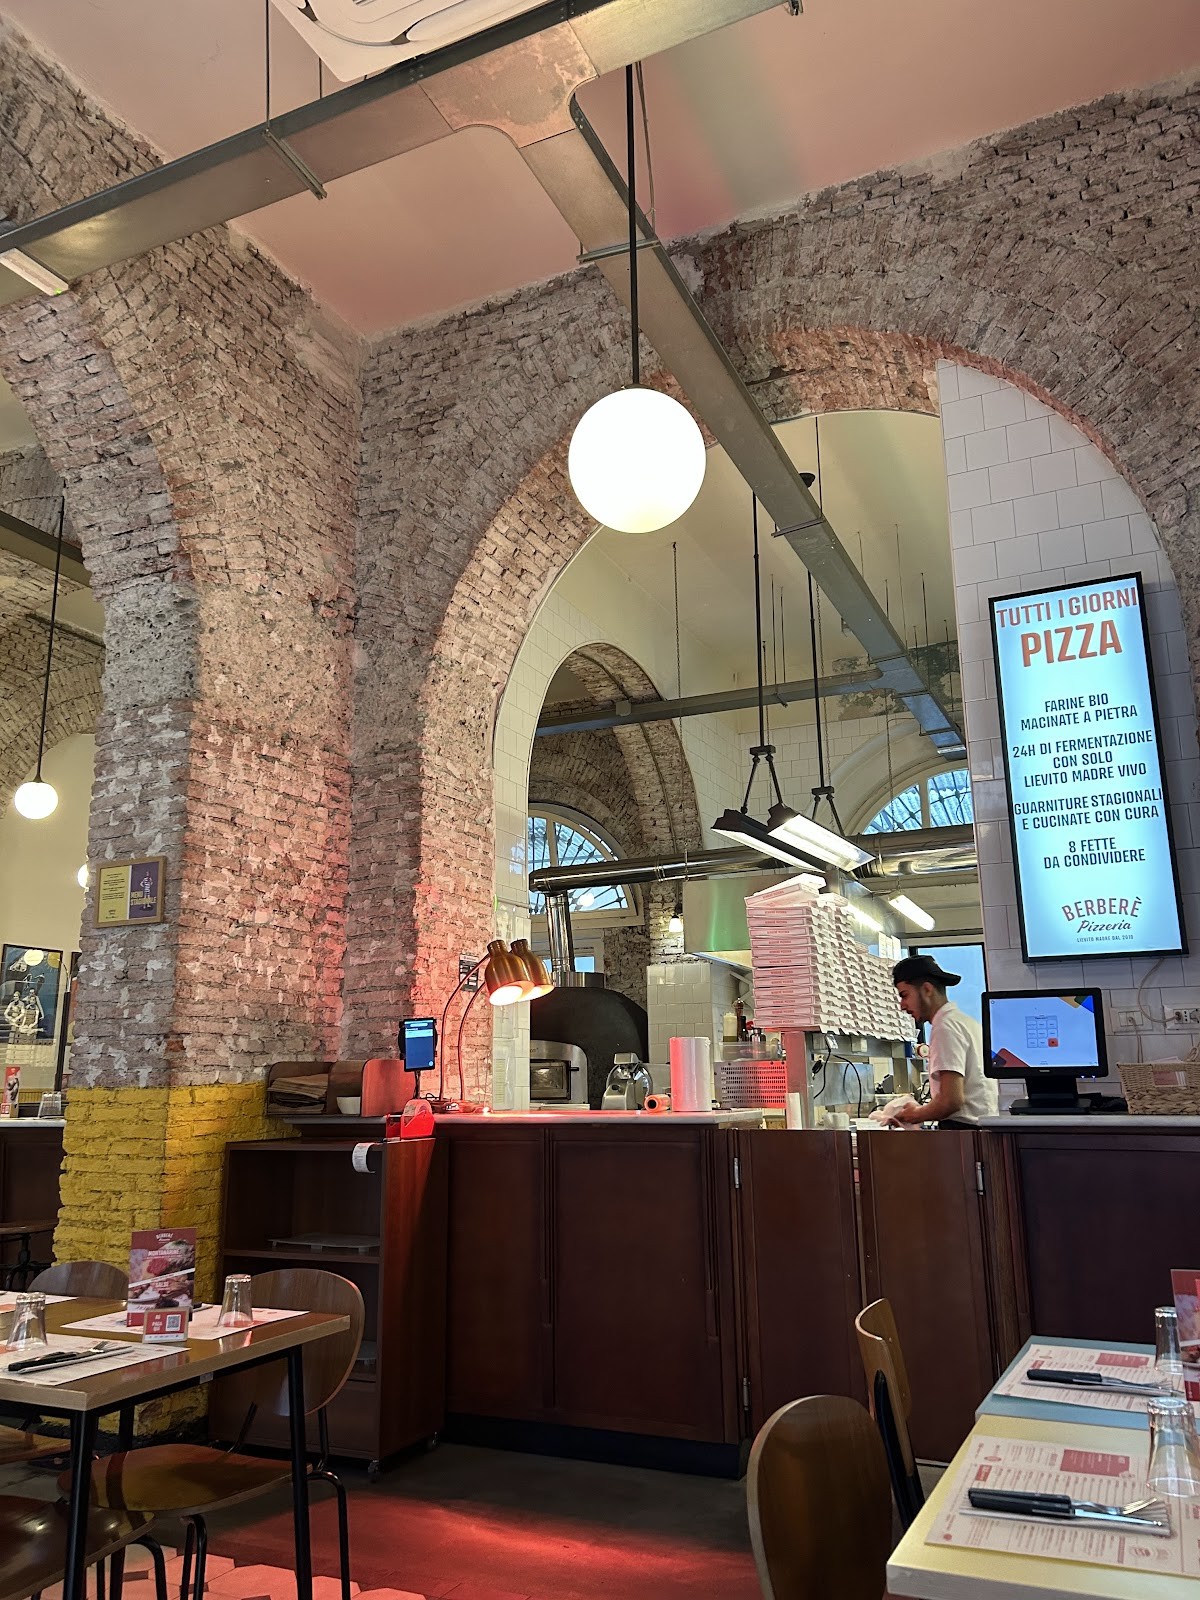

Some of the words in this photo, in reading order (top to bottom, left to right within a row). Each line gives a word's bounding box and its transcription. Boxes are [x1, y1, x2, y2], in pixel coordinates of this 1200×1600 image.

[996, 602, 1052, 627] TUTTI
[1058, 599, 1065, 618] I
[1068, 587, 1138, 617] GIORNI
[1020, 620, 1123, 667] PIZZA
[1044, 696, 1085, 712] FARINE
[1088, 693, 1110, 707] BIO
[1020, 713, 1081, 731] MACINATE
[1083, 711, 1092, 723] A
[1095, 705, 1139, 721] PIETRA
[1012, 745, 1036, 758] 24H
[1039, 742, 1052, 755] DI
[1055, 730, 1154, 753] FERMENTAZIONE
[1052, 755, 1079, 769] CON
[1081, 751, 1113, 765] SOLO
[1023, 771, 1068, 787] LIEVITO
[1072, 766, 1115, 782] MADRE
[1117, 763, 1148, 777] VIVO
[1014, 796, 1090, 815] GUARNITURE
[1090, 788, 1163, 807] STAGIONALI
[1022, 818, 1029, 830] E
[1032, 812, 1092, 829] CUCINATE
[1095, 809, 1121, 823] CON
[1124, 806, 1160, 820] CURA
[1069, 841, 1075, 853] 8
[1080, 837, 1118, 851] FETTE
[1043, 857, 1061, 869] DA
[1063, 849, 1147, 867] CONDIVIDERE
[1060, 896, 1143, 921] BERBERÈ
[1076, 920, 1133, 933] Pizzeria
